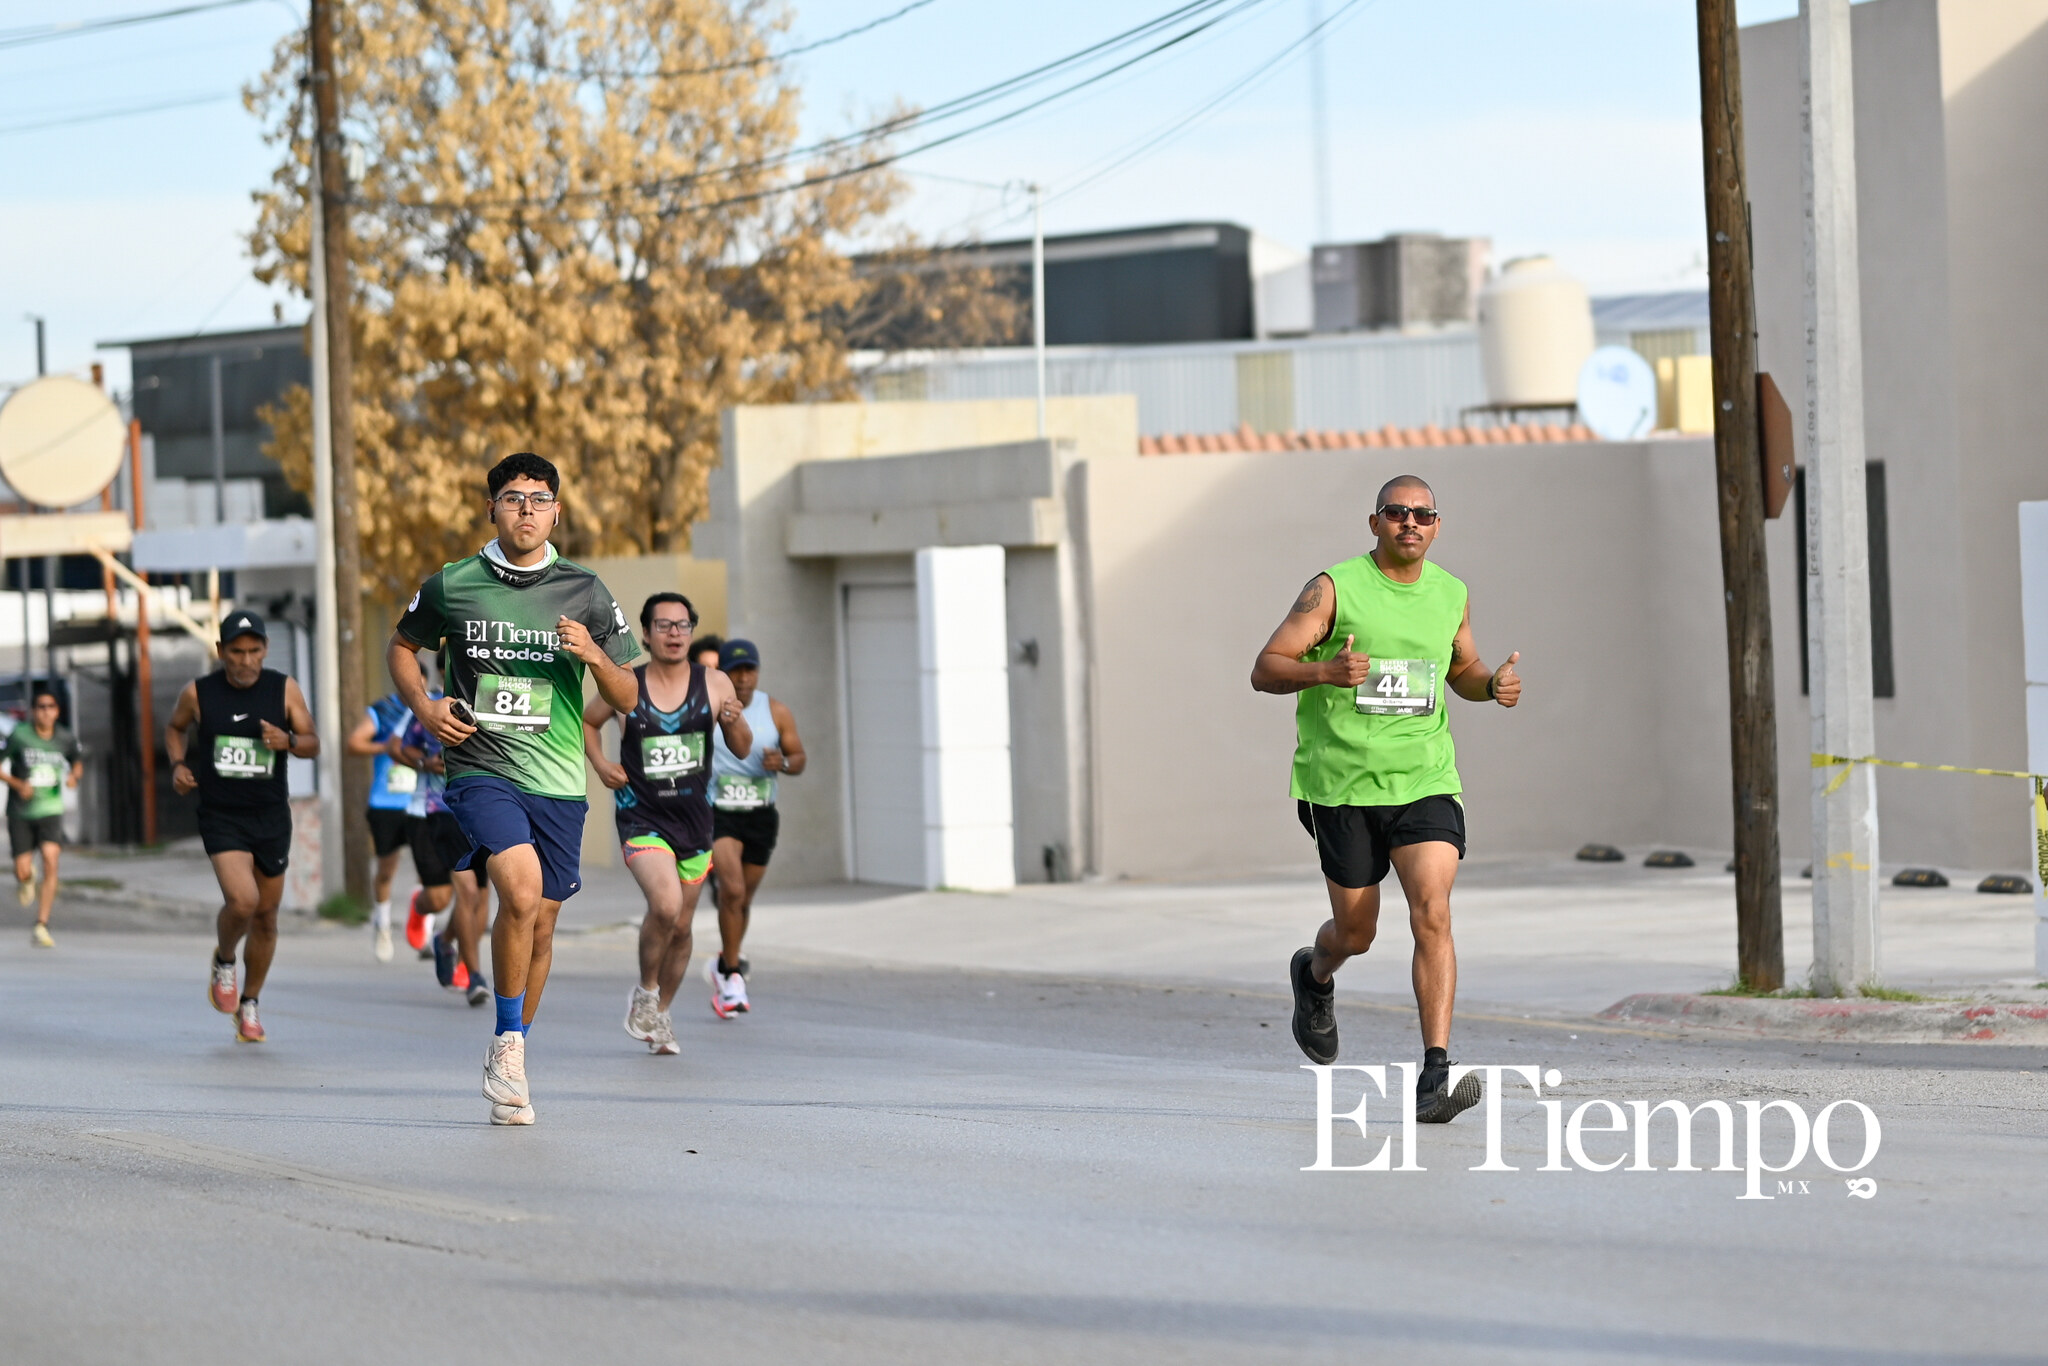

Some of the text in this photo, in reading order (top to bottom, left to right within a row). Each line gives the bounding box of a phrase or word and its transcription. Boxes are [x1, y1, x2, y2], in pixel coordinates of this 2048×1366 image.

[464, 620, 561, 651] El Tiemp
[467, 645, 555, 662] de todos
[499, 676, 532, 684] CARRERA
[1376, 674, 1409, 697] 44
[1428, 672, 1436, 709] MEDALLA
[494, 690, 531, 715] 84
[220, 746, 257, 766] 501
[650, 746, 691, 766] 320
[723, 785, 758, 801] 305
